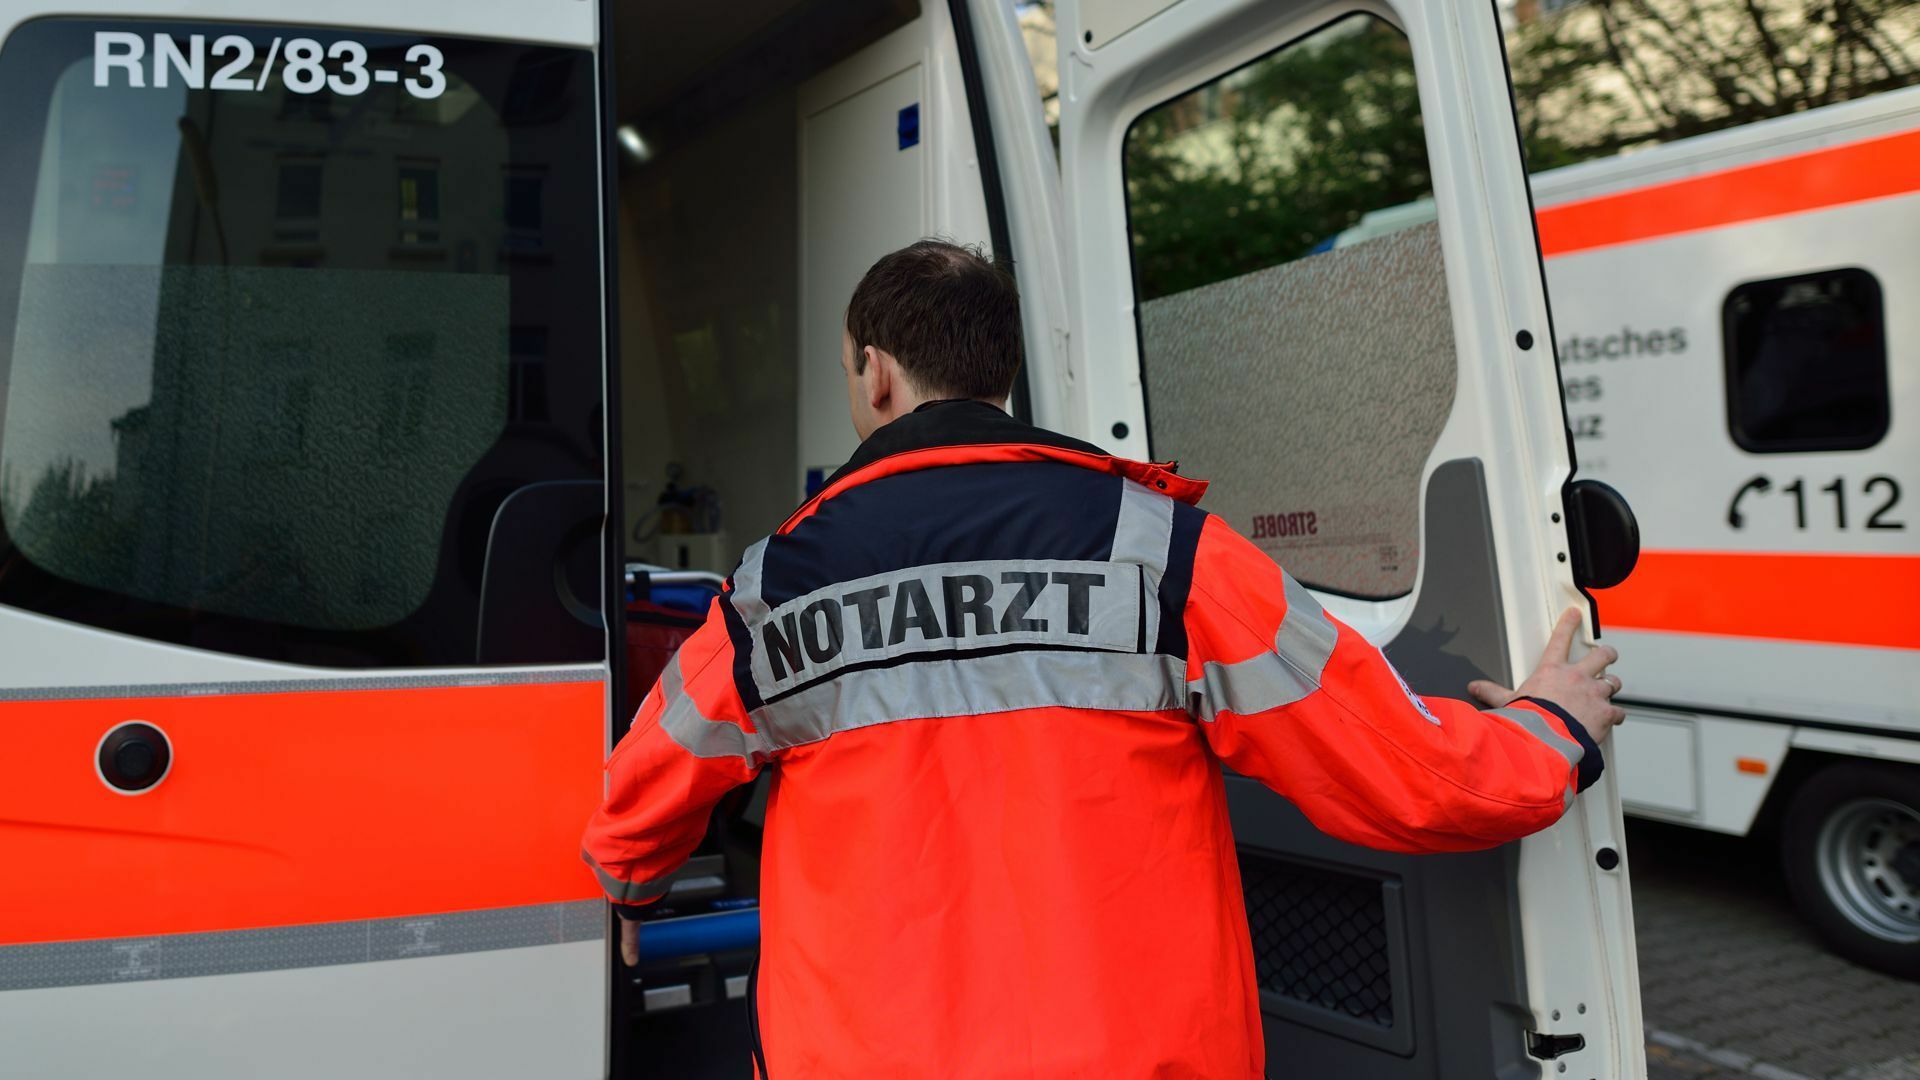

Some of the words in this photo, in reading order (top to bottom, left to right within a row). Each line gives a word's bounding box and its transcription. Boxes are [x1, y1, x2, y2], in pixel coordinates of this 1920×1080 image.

[94, 31, 447, 99] RN2/83-3
[1781, 475, 1906, 531] 112
[763, 571, 1106, 682] NOTARZT
